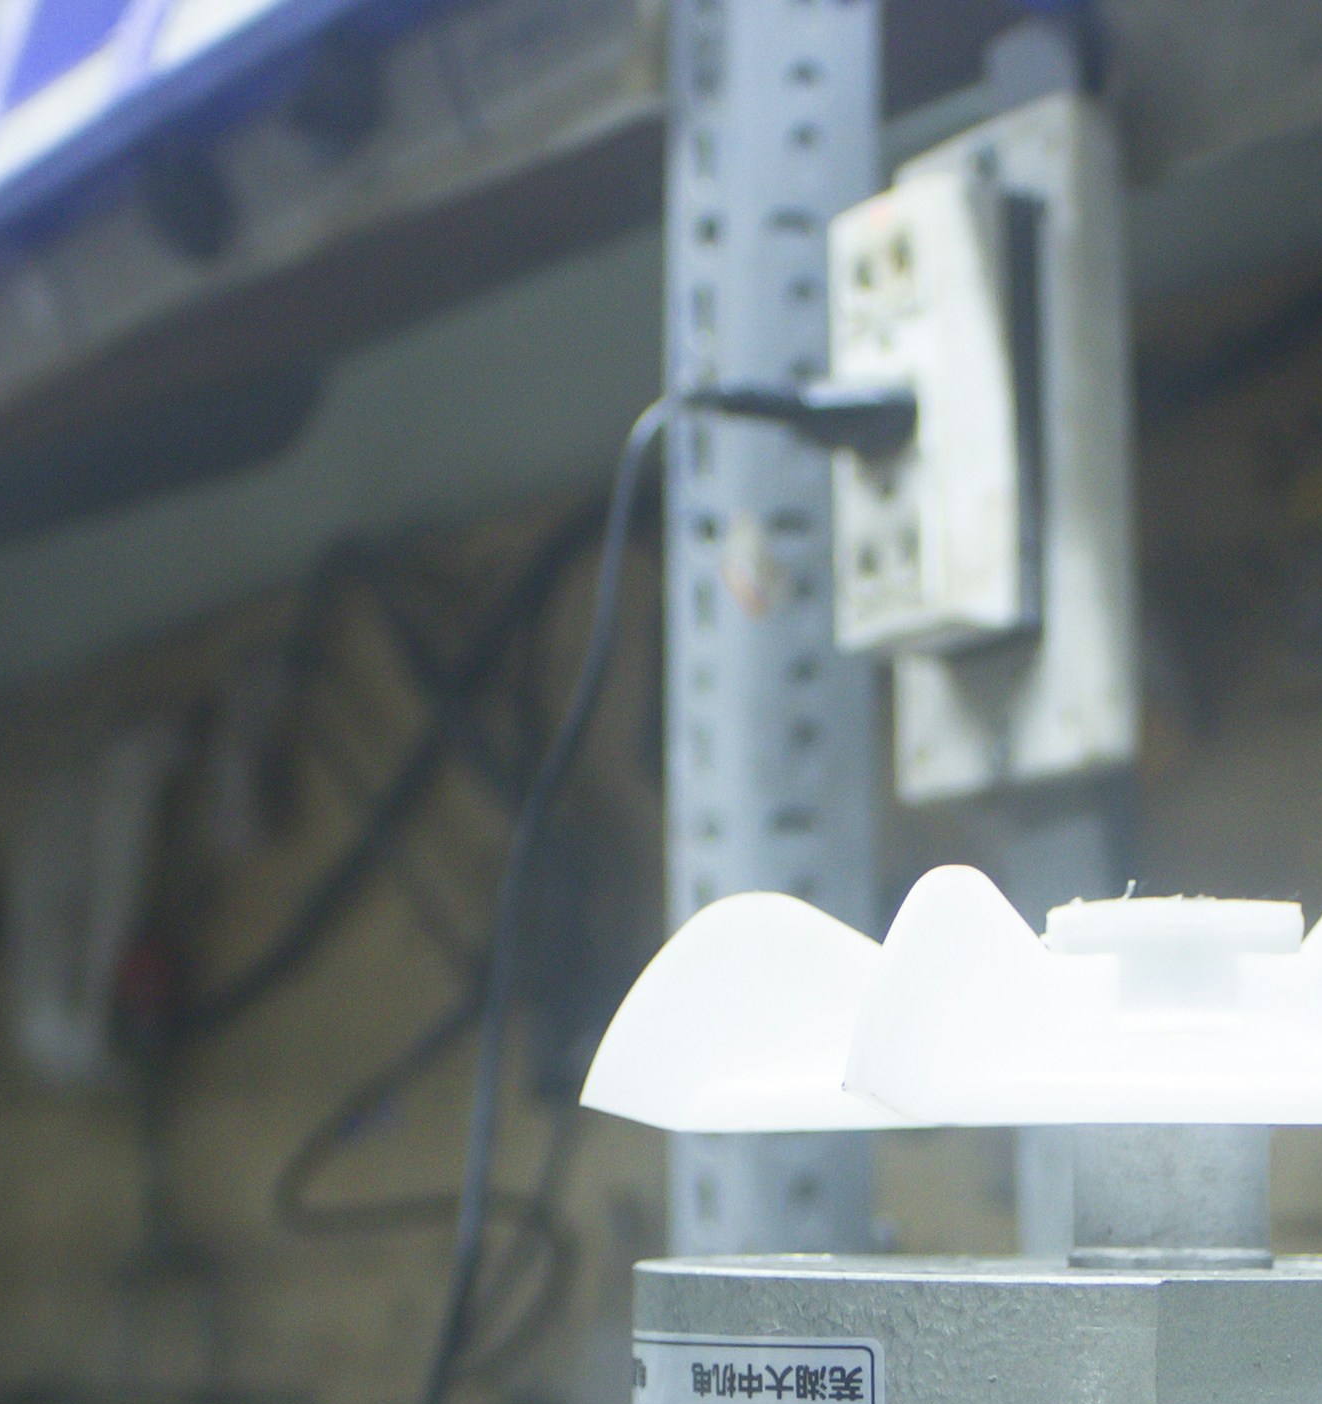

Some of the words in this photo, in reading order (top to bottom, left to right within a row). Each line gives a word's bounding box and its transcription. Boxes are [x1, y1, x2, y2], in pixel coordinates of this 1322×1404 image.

[692, 1362, 863, 1402] 芜湖大中机电
